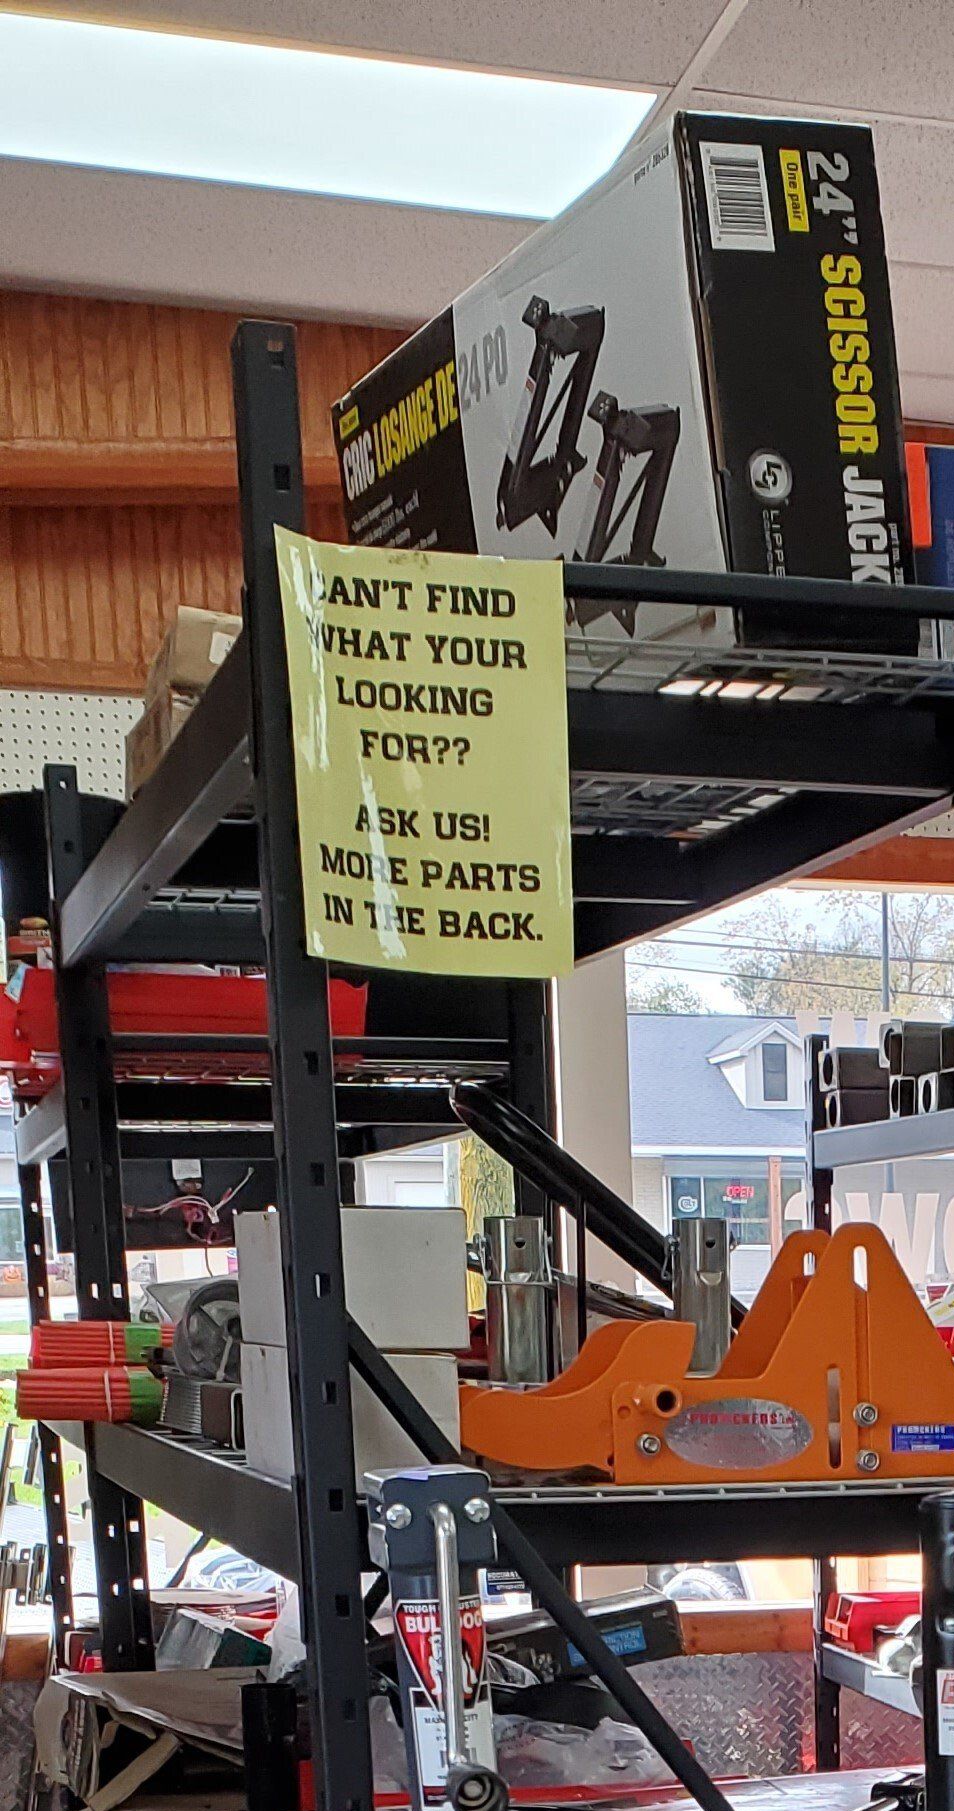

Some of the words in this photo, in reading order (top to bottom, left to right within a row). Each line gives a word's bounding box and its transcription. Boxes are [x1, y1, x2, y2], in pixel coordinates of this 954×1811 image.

[785, 162, 798, 195] One
[791, 193, 802, 222] pair
[820, 254, 879, 455] SCISSOR
[342, 430, 375, 501] CRIC
[372, 377, 438, 478] LOSANGE
[435, 361, 458, 429] DE
[458, 344, 481, 412] 24
[483, 325, 508, 396] PO
[770, 510, 785, 578] LIPPE
[843, 465, 891, 584] JACK
[426, 583, 516, 617] FIND
[307, 622, 411, 661] WHAT
[425, 635, 527, 669] YOUR
[335, 676, 493, 716] LOOKING
[360, 729, 470, 764] FOR??
[355, 805, 420, 838] ASK
[434, 813, 490, 842] US!
[319, 844, 408, 885] MORE
[420, 860, 541, 892] PARTS
[324, 893, 353, 925] IN
[365, 901, 425, 935] THE
[438, 910, 544, 942] BACK.
[726, 1186, 754, 1198] OPEN
[404, 1614, 482, 1634] BULDOG
